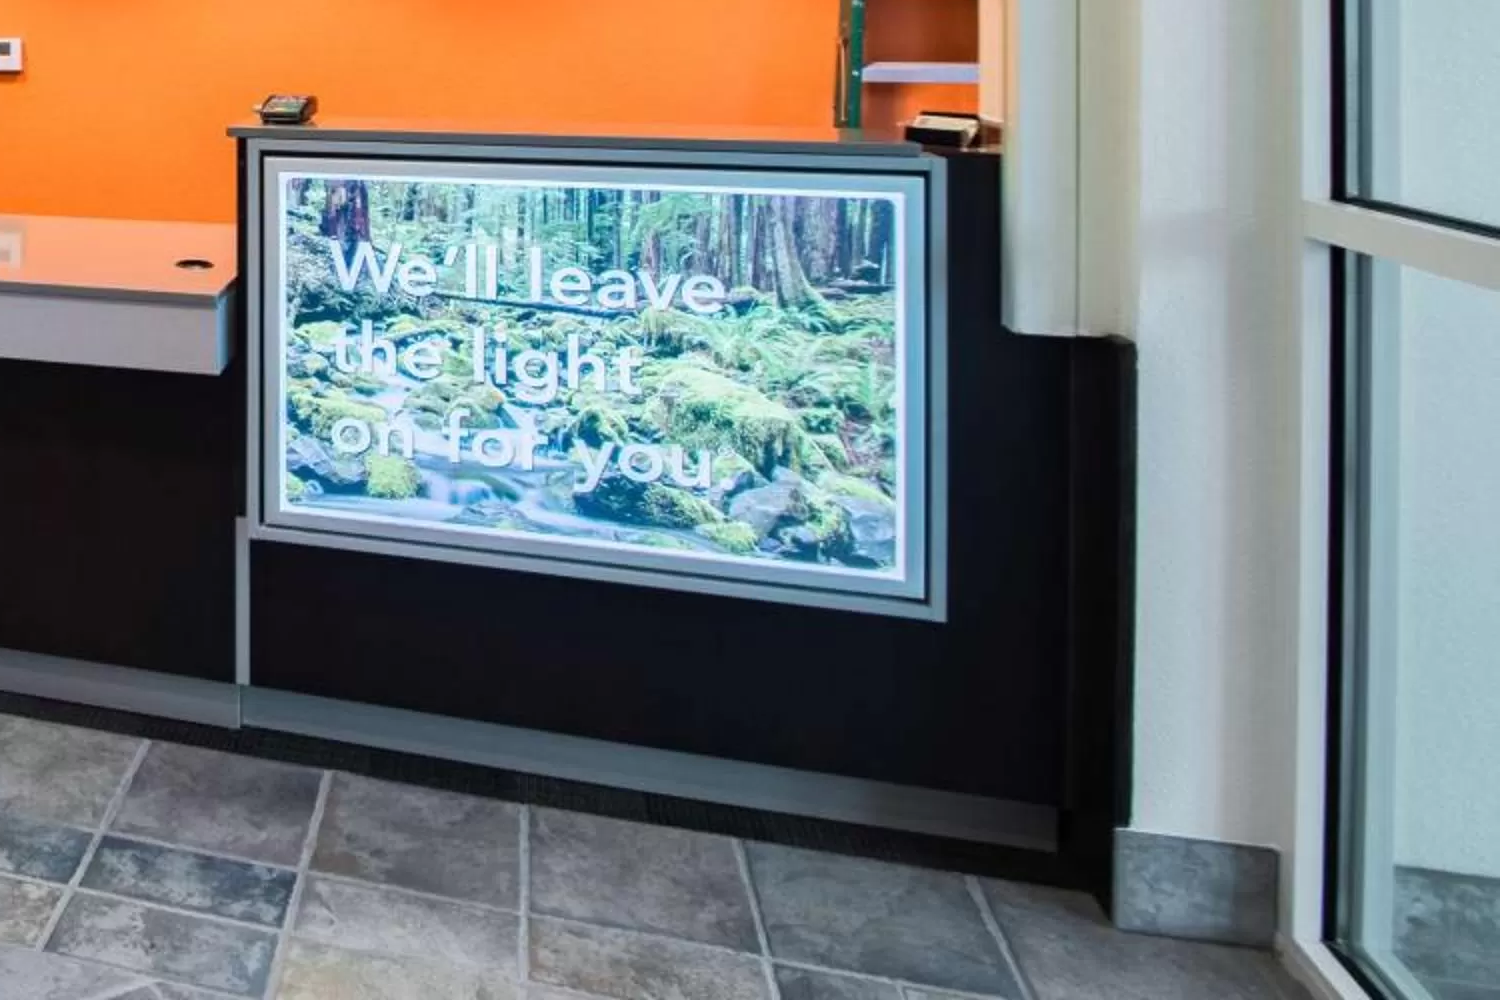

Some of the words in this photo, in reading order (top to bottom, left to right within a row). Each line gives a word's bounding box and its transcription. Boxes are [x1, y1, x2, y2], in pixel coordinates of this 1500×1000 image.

[331, 239, 498, 300] We'll
[530, 247, 727, 313] leave
[335, 319, 443, 380] the
[472, 326, 642, 403] light
[331, 418, 414, 459] on
[443, 407, 548, 471] for
